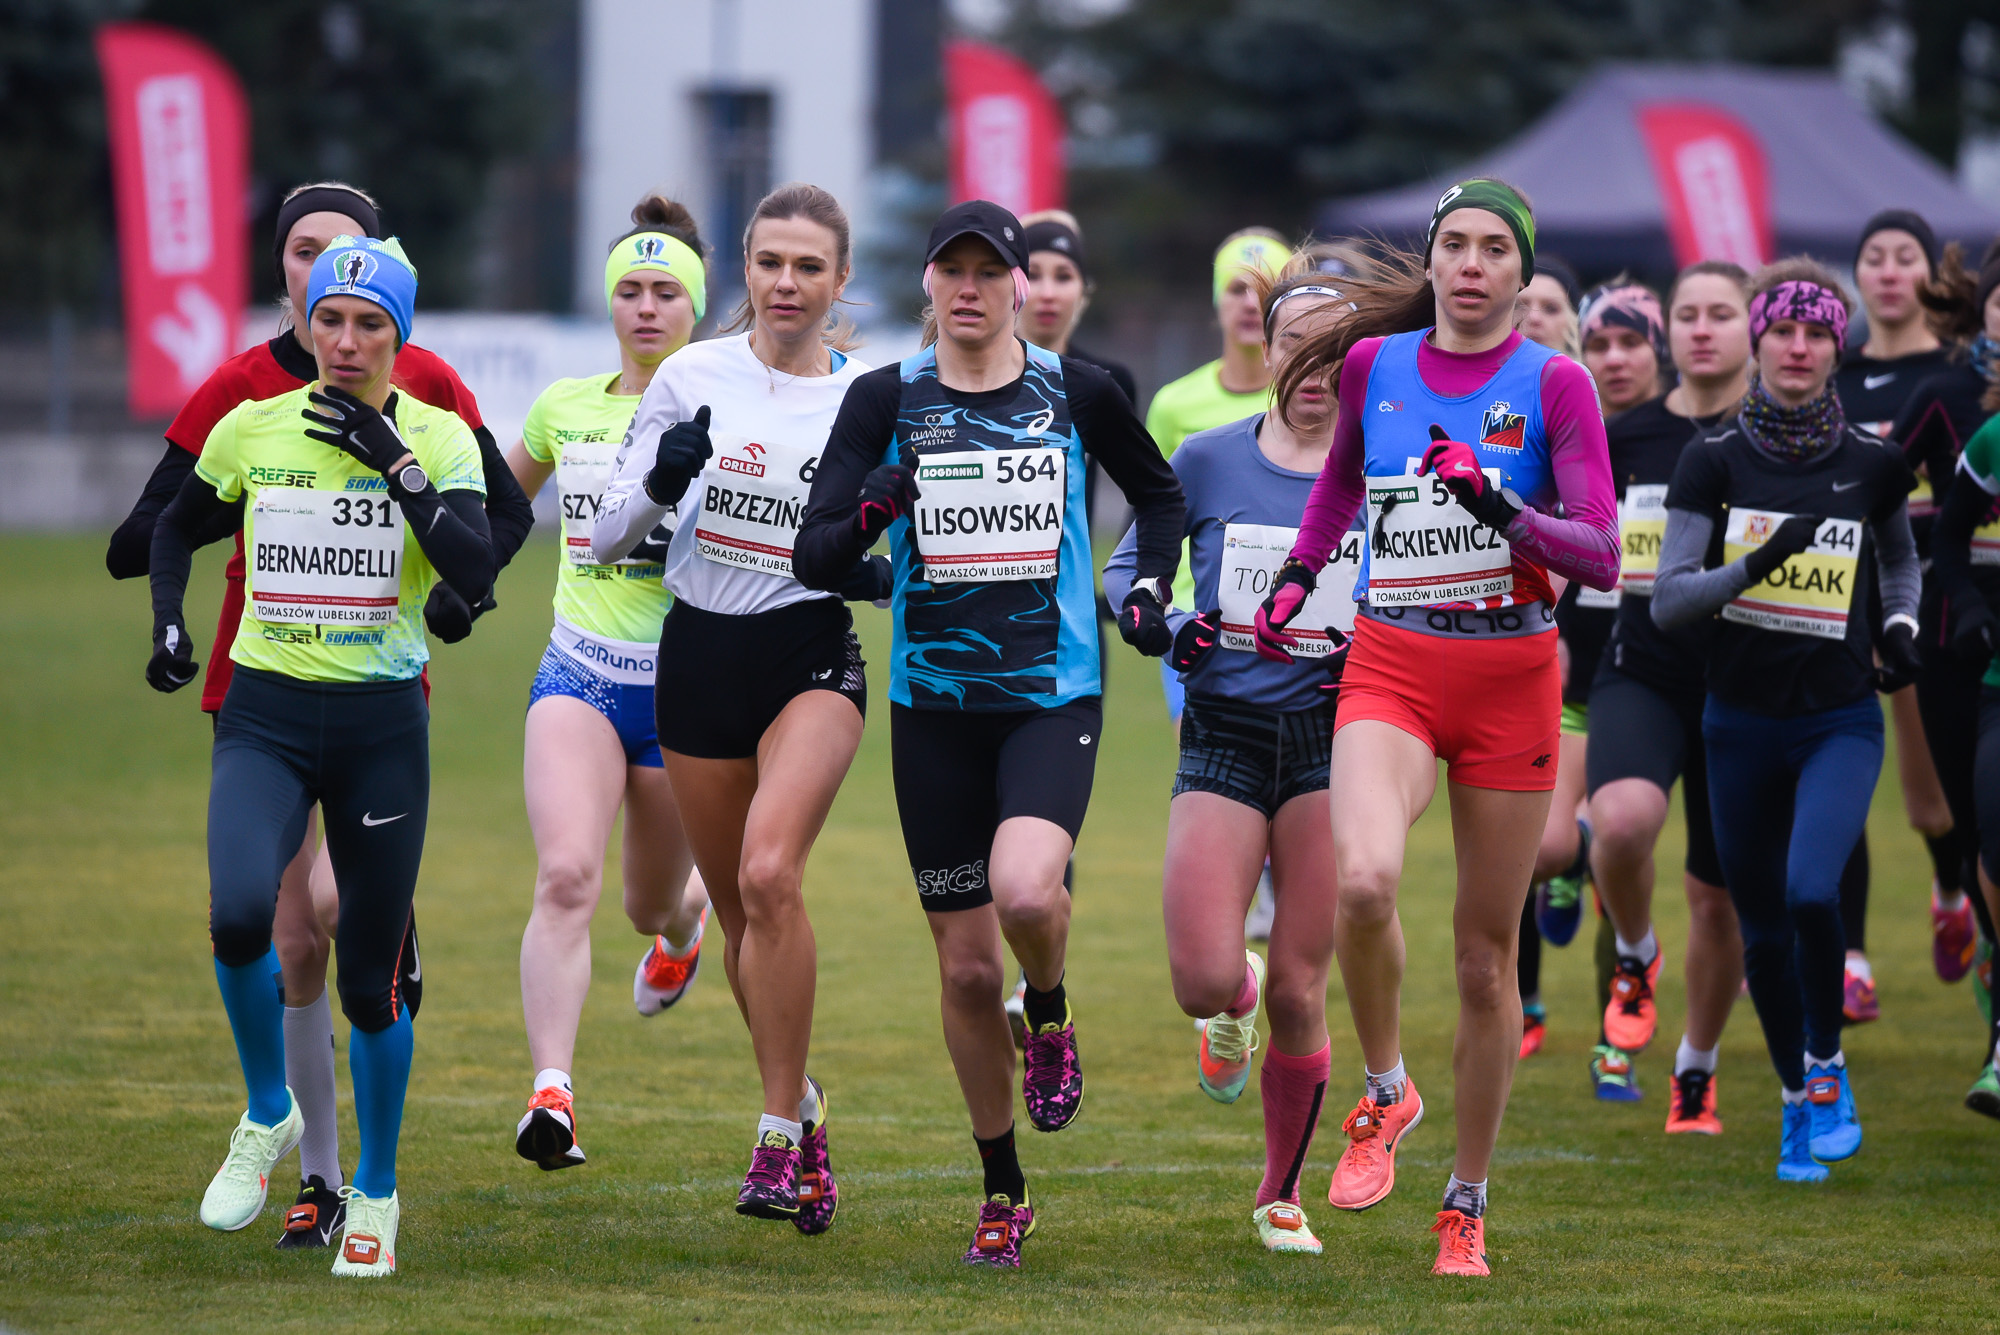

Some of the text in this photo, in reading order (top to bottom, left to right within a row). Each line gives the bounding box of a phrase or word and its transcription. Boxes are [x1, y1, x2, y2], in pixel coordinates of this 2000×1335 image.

[922, 439, 945, 447] PASTA
[1482, 445, 1520, 456] SZCZECIN
[722, 457, 764, 476] ORLEN
[922, 466, 981, 478] BOGDANKA
[996, 454, 1057, 484] 564
[331, 497, 395, 529] 331
[920, 502, 1060, 536] LISOWSKA
[256, 542, 396, 578] BERNARDELLI
[991, 564, 1037, 577] LUBELSKI
[1375, 579, 1508, 603] TOMASZÓW LUBELSKI 2021
[257, 605, 392, 621] TOMASZÓW LUBELSKI 2021
[1531, 753, 1552, 768] 4F
[911, 860, 985, 896] SICS
